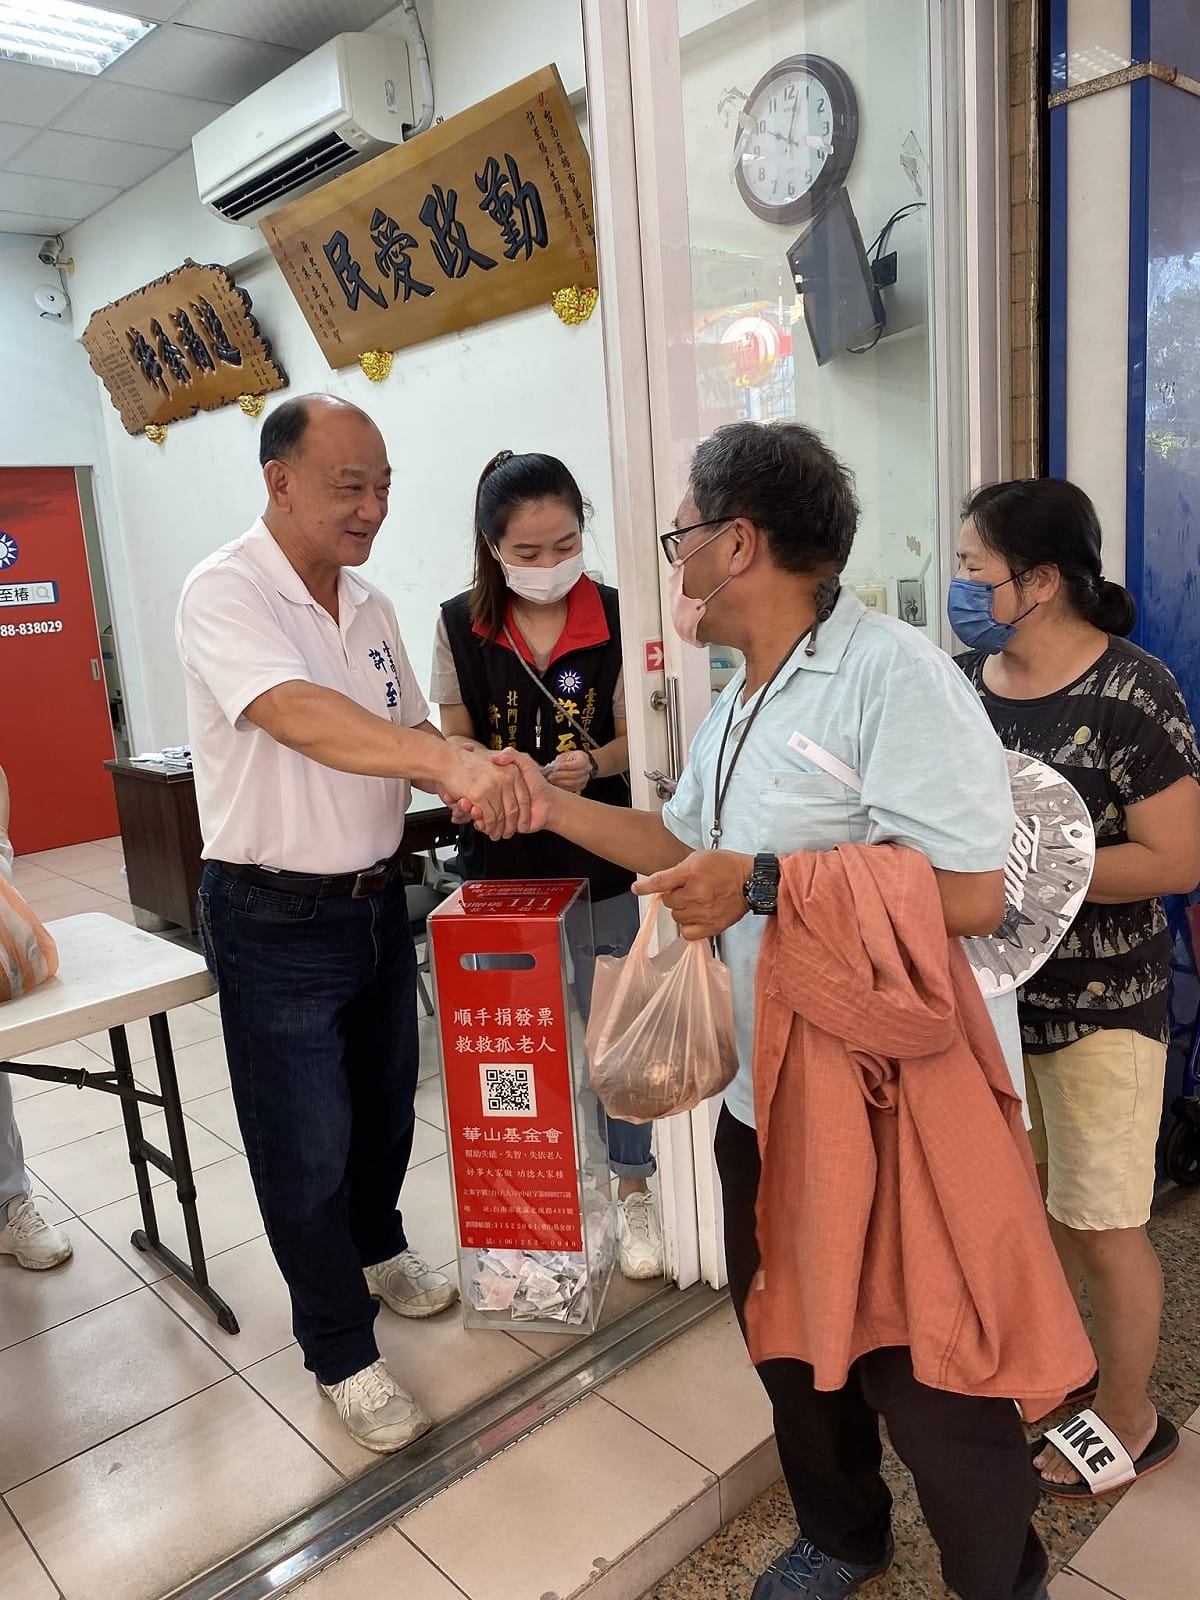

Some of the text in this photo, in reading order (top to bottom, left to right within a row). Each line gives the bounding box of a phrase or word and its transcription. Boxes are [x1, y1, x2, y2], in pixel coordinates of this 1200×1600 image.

[784, 84, 796, 101] 12
[804, 85, 810, 100] 1
[768, 97, 778, 113] 11
[816, 98, 825, 113] 2
[821, 121, 830, 137] 3
[758, 167, 766, 181] 8
[787, 181, 796, 196] 6
[323, 153, 549, 311] 勤政愛民
[506, 690, 519, 749] 北門里
[453, 1007, 554, 1027] 順手捐發票
[455, 1035, 556, 1053] 救救孤老人
[462, 1126, 563, 1144] 華山基金會
